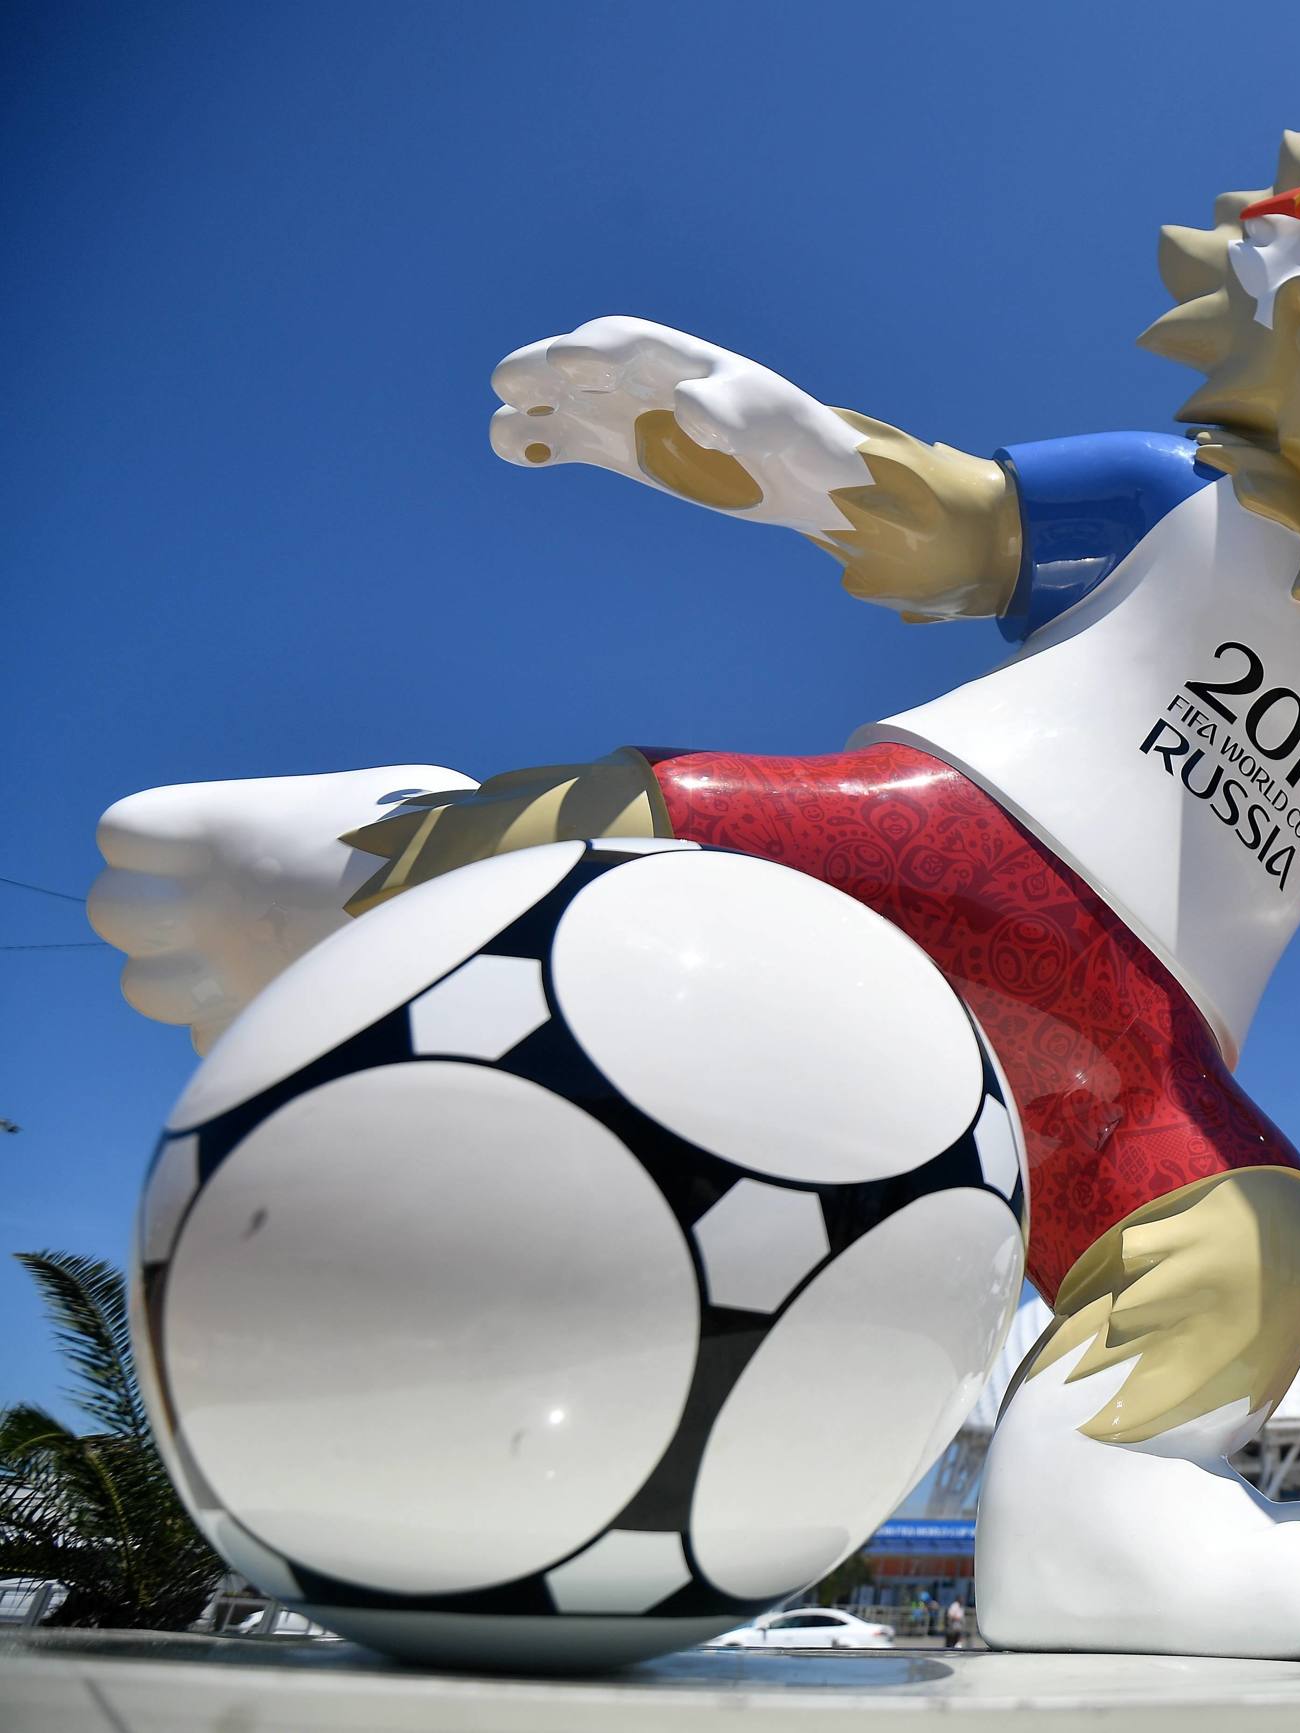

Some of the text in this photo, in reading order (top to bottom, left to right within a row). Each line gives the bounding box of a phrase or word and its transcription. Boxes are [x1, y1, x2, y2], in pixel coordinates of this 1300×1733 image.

[1139, 717, 1296, 892] RUSSIA
[1166, 694, 1218, 746] FIFA
[1220, 735, 1289, 812] WORLD
